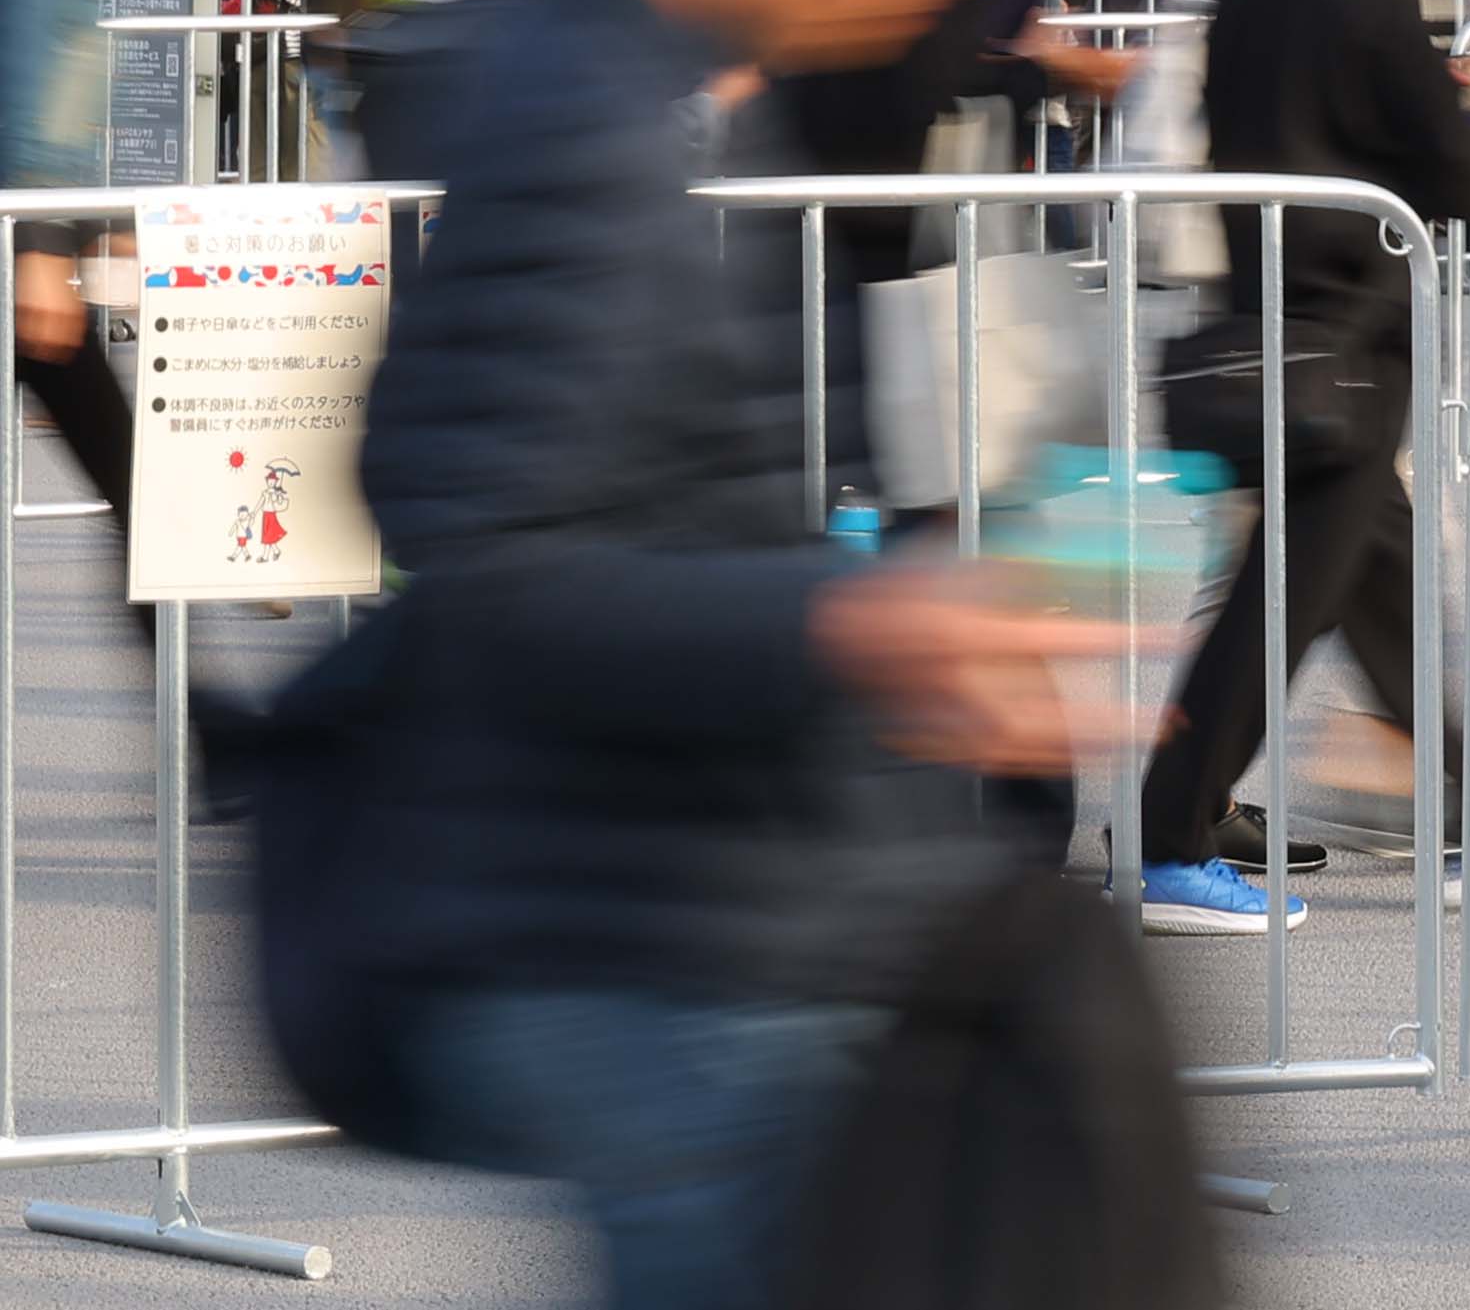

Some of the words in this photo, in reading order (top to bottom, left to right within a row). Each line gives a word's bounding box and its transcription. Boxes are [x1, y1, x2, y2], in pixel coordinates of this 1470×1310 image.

[184, 233, 347, 254] 暑さ対策のお願い
[172, 314, 369, 332] 帽子や日傘などをご利用ください
[171, 354, 362, 372] こまめに水分・塩分を補給しましょう
[170, 394, 366, 413] 体調不良時は、お近くのスタッフや
[170, 415, 346, 432] 警備員にすぐお声がけください
